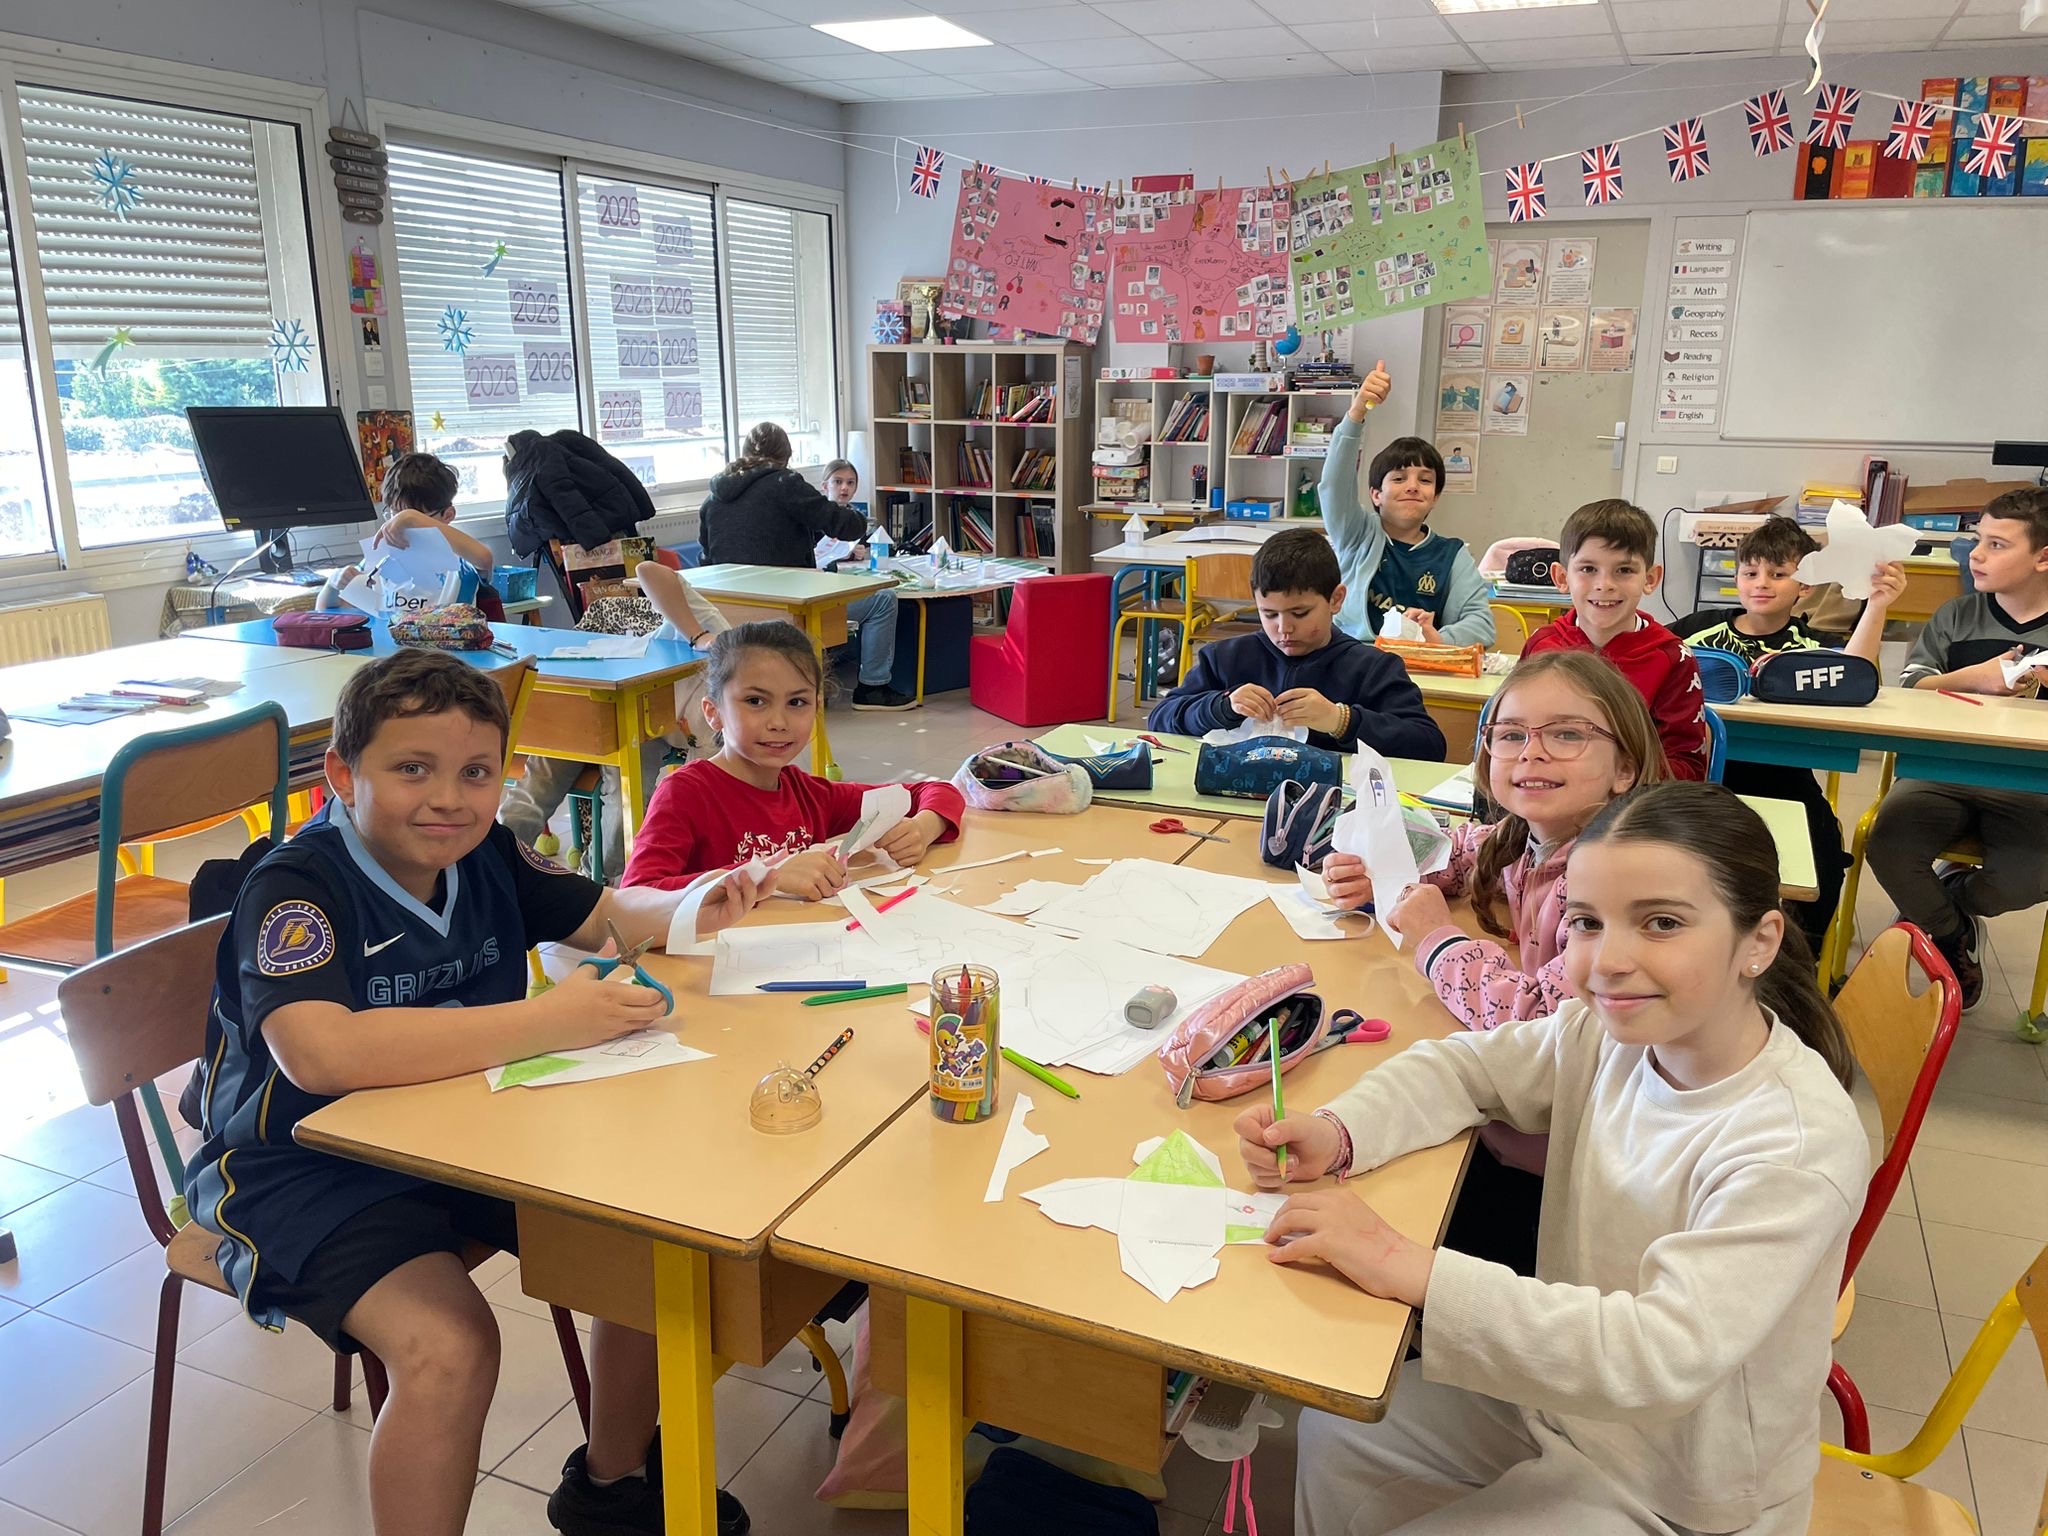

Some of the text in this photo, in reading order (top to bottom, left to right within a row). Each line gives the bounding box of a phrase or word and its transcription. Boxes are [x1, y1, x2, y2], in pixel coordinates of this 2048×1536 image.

[599, 195, 641, 226] 2026
[656, 225, 693, 254] 2026
[1695, 243, 1722, 252] Writing
[1689, 265, 1724, 274] Language
[613, 284, 653, 313] 2026
[656, 286, 693, 314] 2026
[1693, 286, 1717, 295] Math
[513, 291, 559, 324] 2026
[1684, 309, 1725, 319] Geography
[1689, 329, 1718, 338] Recess
[620, 338, 660, 367] 2026
[662, 337, 698, 365] 2026
[1683, 353, 1712, 362] Reading
[527, 351, 573, 381] 2026
[1681, 373, 1715, 382] Religion
[467, 365, 518, 397] 2026
[601, 400, 642, 429] 2026
[666, 391, 702, 417] 2026
[1678, 411, 1704, 420] English
[386, 592, 428, 609] Uber
[1795, 665, 1845, 691] FFF
